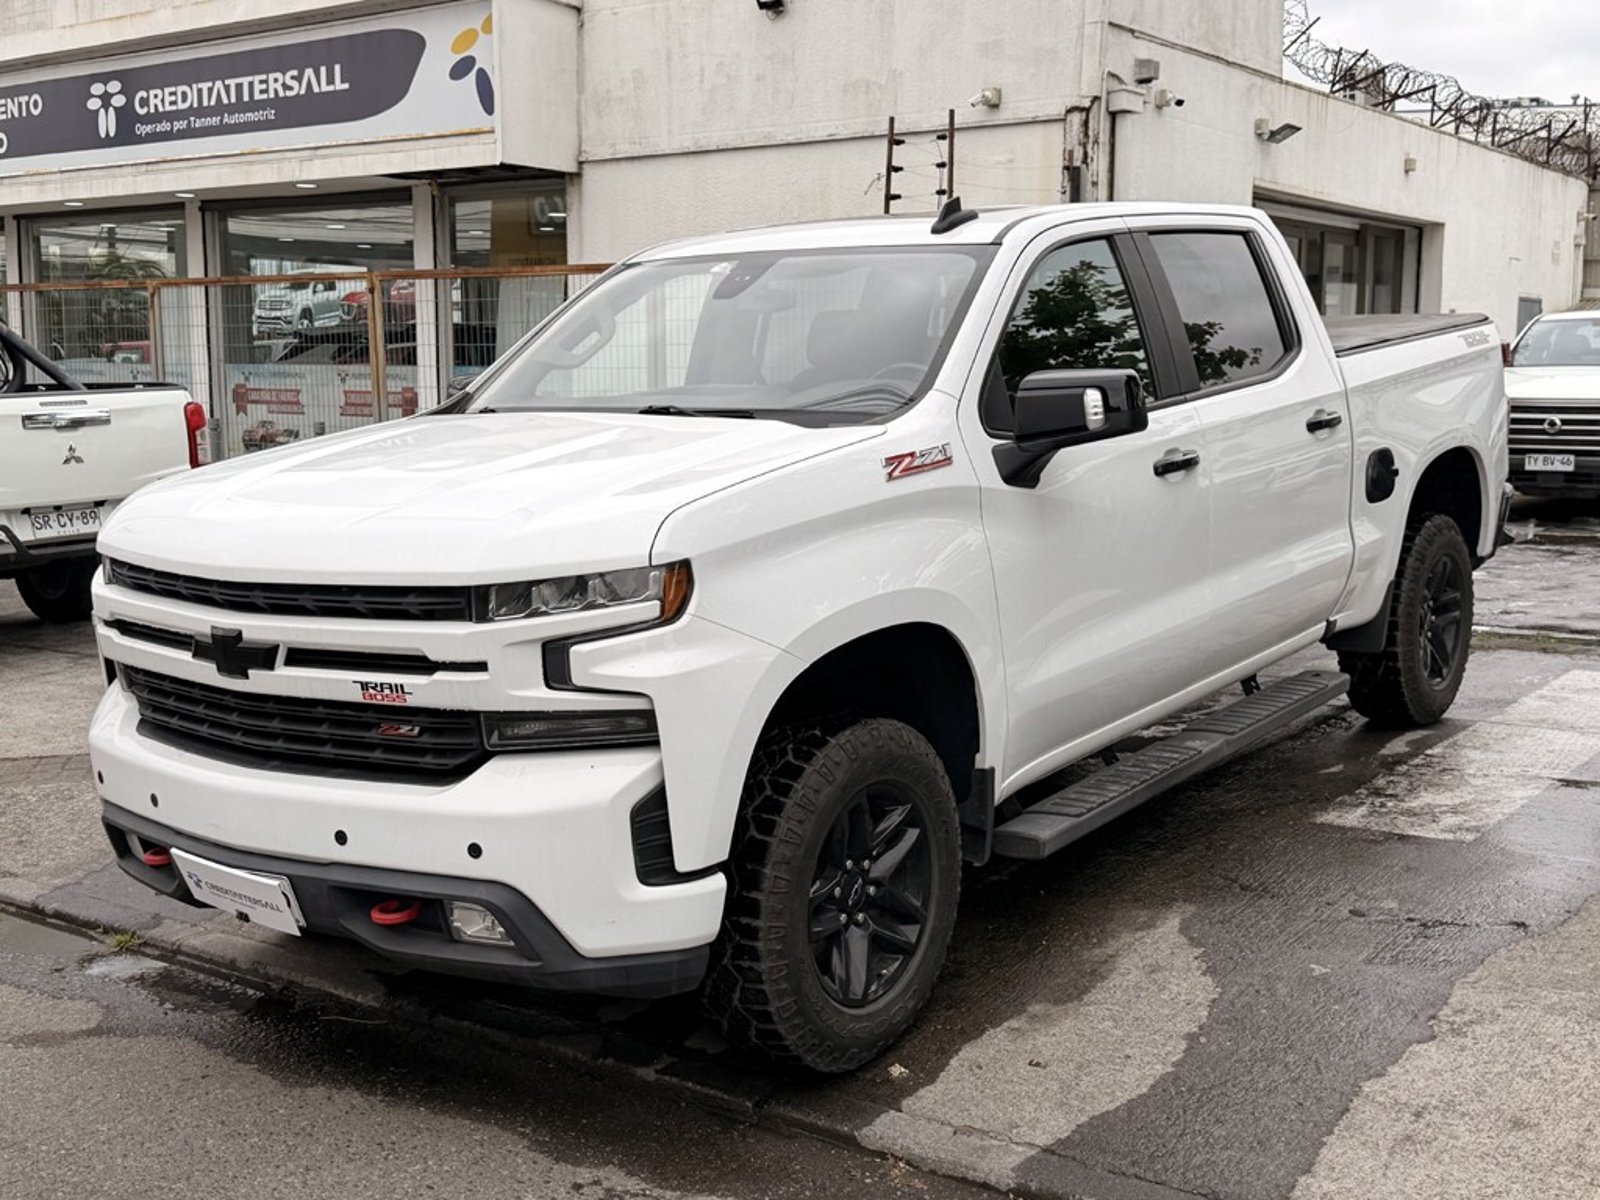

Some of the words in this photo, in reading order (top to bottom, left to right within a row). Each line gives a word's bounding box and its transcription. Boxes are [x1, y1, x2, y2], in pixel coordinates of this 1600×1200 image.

[134, 64, 349, 115] CREDITATTERSALL
[135, 119, 172, 137] Operado
[173, 118, 188, 133] por
[189, 115, 221, 129] Tanner
[222, 107, 276, 124] Automotriz
[882, 442, 953, 482] Z71
[352, 680, 413, 695] TRAIL
[362, 692, 407, 703] BOSS
